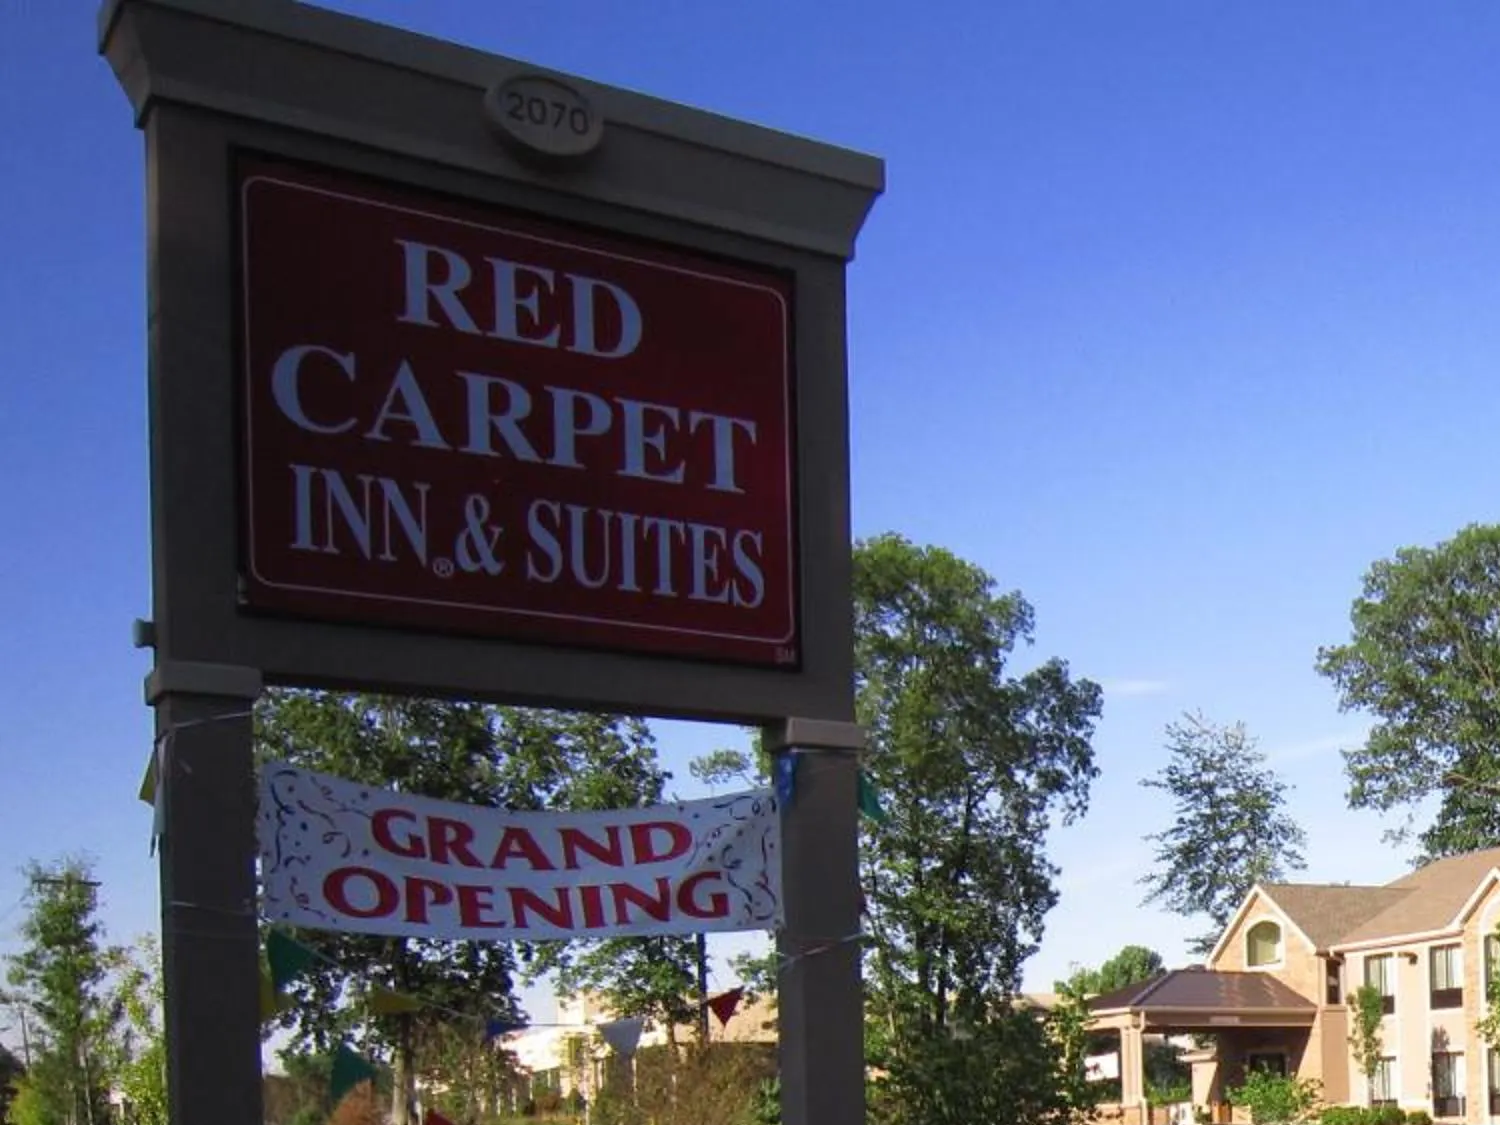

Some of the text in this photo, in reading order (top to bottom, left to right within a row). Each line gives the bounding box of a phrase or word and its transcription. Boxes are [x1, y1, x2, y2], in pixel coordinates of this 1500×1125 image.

[506, 91, 590, 136] 2070
[394, 239, 644, 359] RED
[271, 344, 757, 494] CARPET
[455, 493, 505, 576] &
[526, 498, 765, 609] SUITES
[370, 807, 694, 872] GRAND
[322, 866, 731, 930] OPENING
